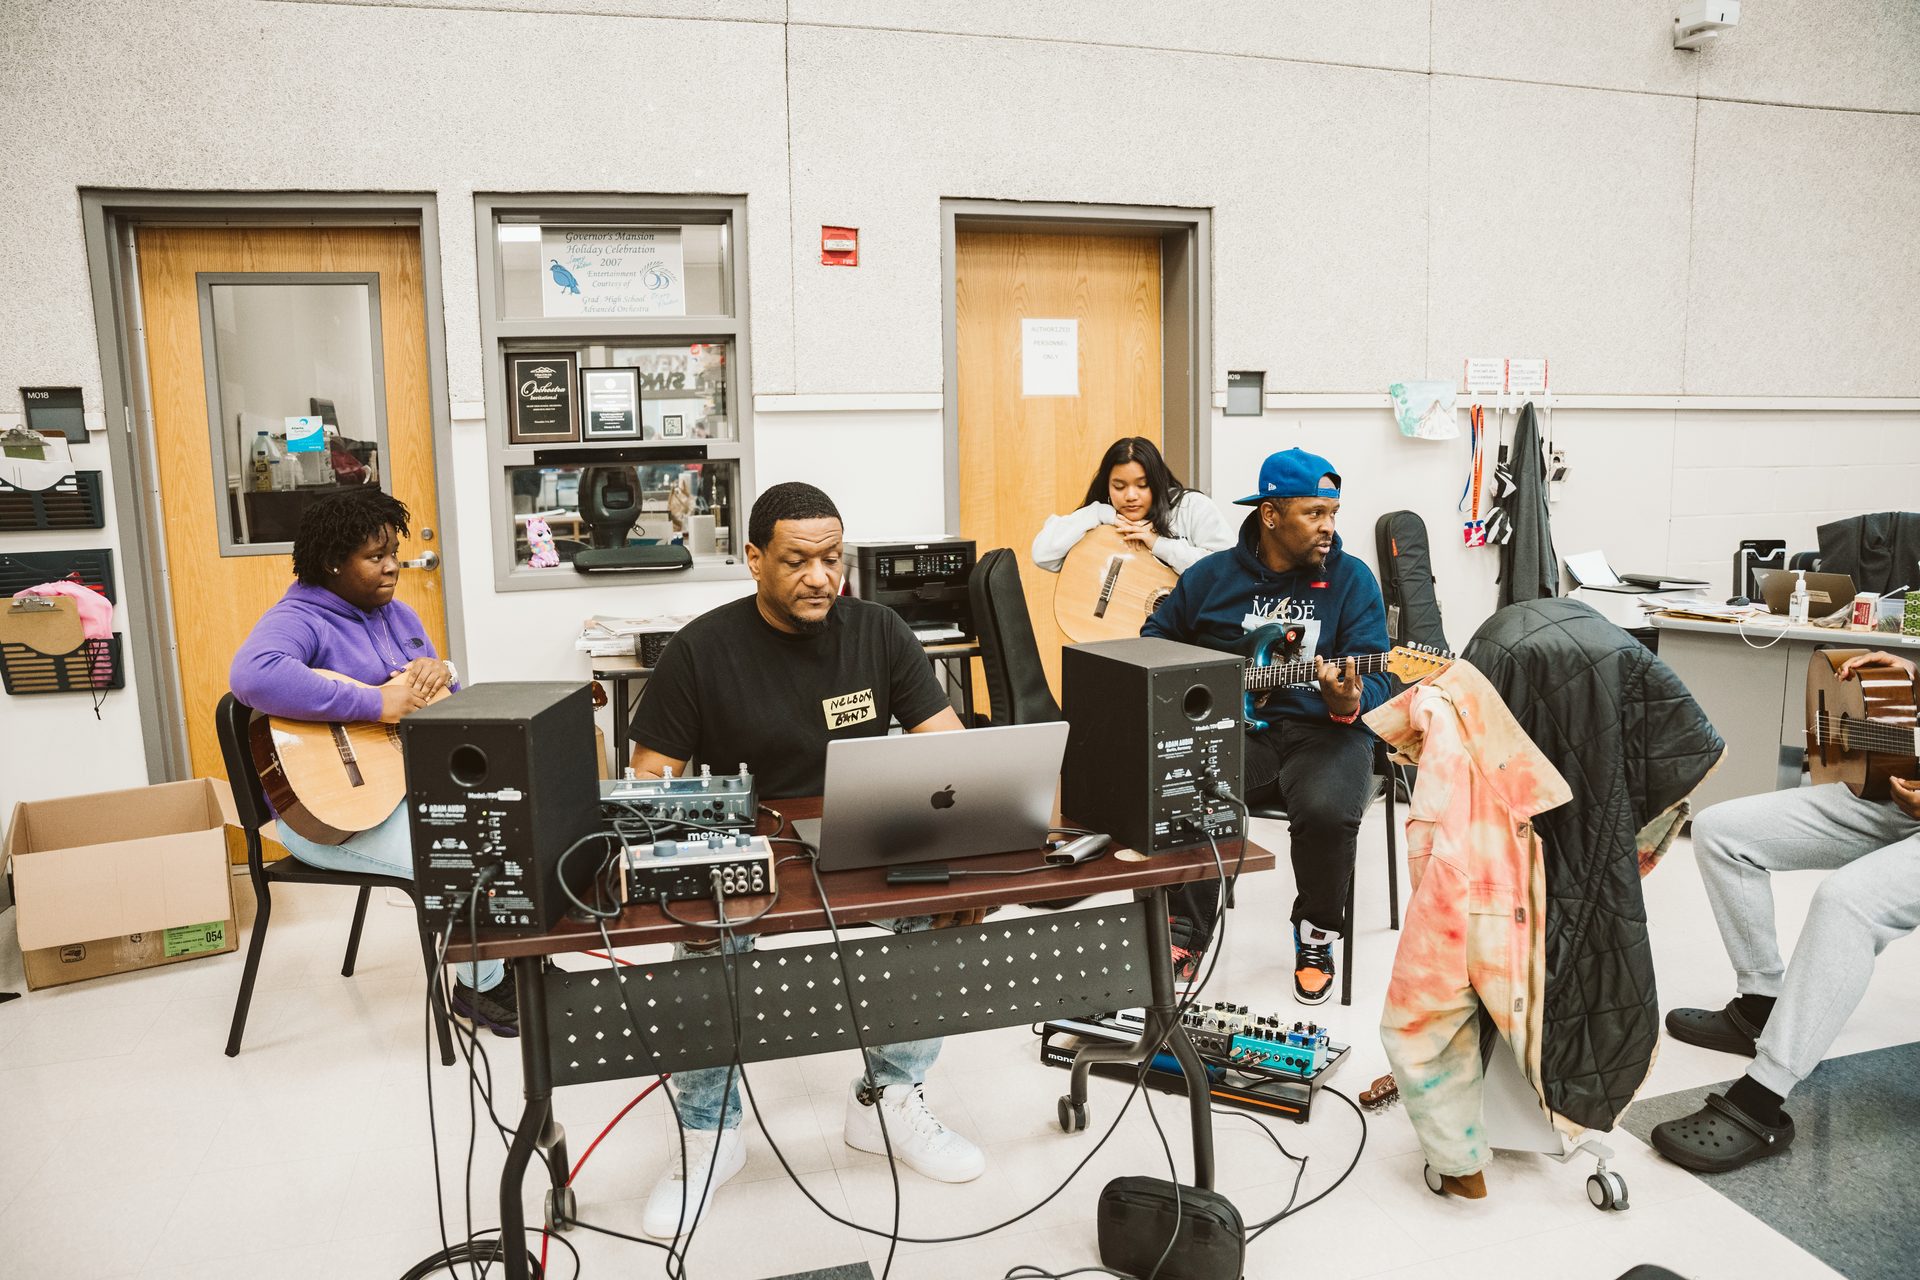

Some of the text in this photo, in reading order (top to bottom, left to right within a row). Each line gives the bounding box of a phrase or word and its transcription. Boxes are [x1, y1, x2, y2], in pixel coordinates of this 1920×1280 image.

[565, 231, 655, 244] Governor's Mansion
[566, 244, 656, 256] Holiday Celebration
[600, 258, 623, 267] 2007
[587, 270, 637, 278] Entertainment
[592, 279, 632, 289] Courtesy of
[604, 295, 621, 305] High
[622, 295, 645, 304] School
[580, 304, 649, 314] Advanced Orchestra
[520, 380, 566, 397] Orchestra
[27, 391, 50, 399] M018
[1252, 597, 1316, 622] MADE
[205, 929, 223, 943] 054
